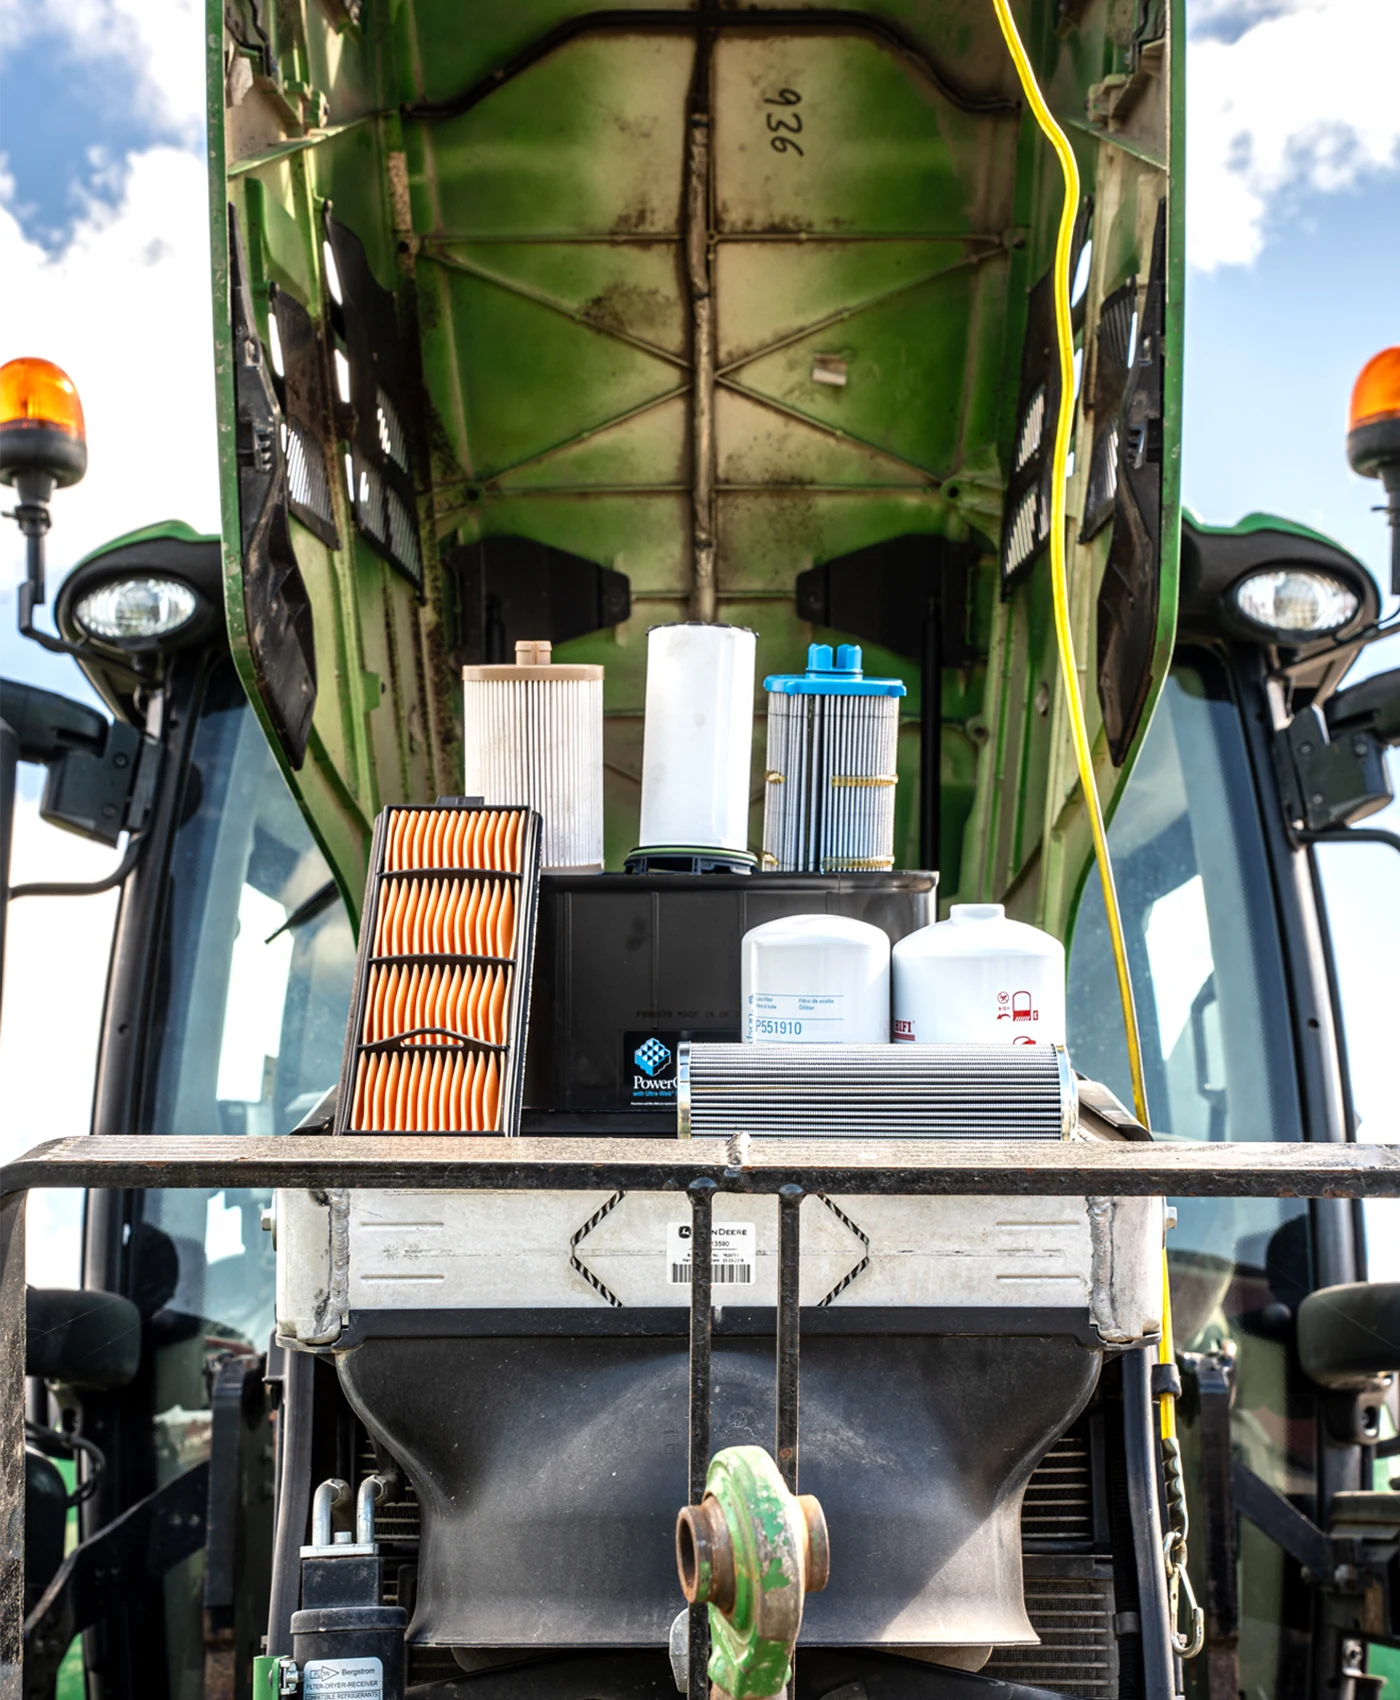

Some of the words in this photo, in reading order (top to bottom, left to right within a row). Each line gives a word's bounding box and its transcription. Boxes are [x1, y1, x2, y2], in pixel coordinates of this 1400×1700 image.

[763, 87, 804, 157] 936
[756, 1019, 802, 1035] P551910
[719, 1228, 747, 1236] DEERE
[341, 1668, 376, 1677] Bergstrom
